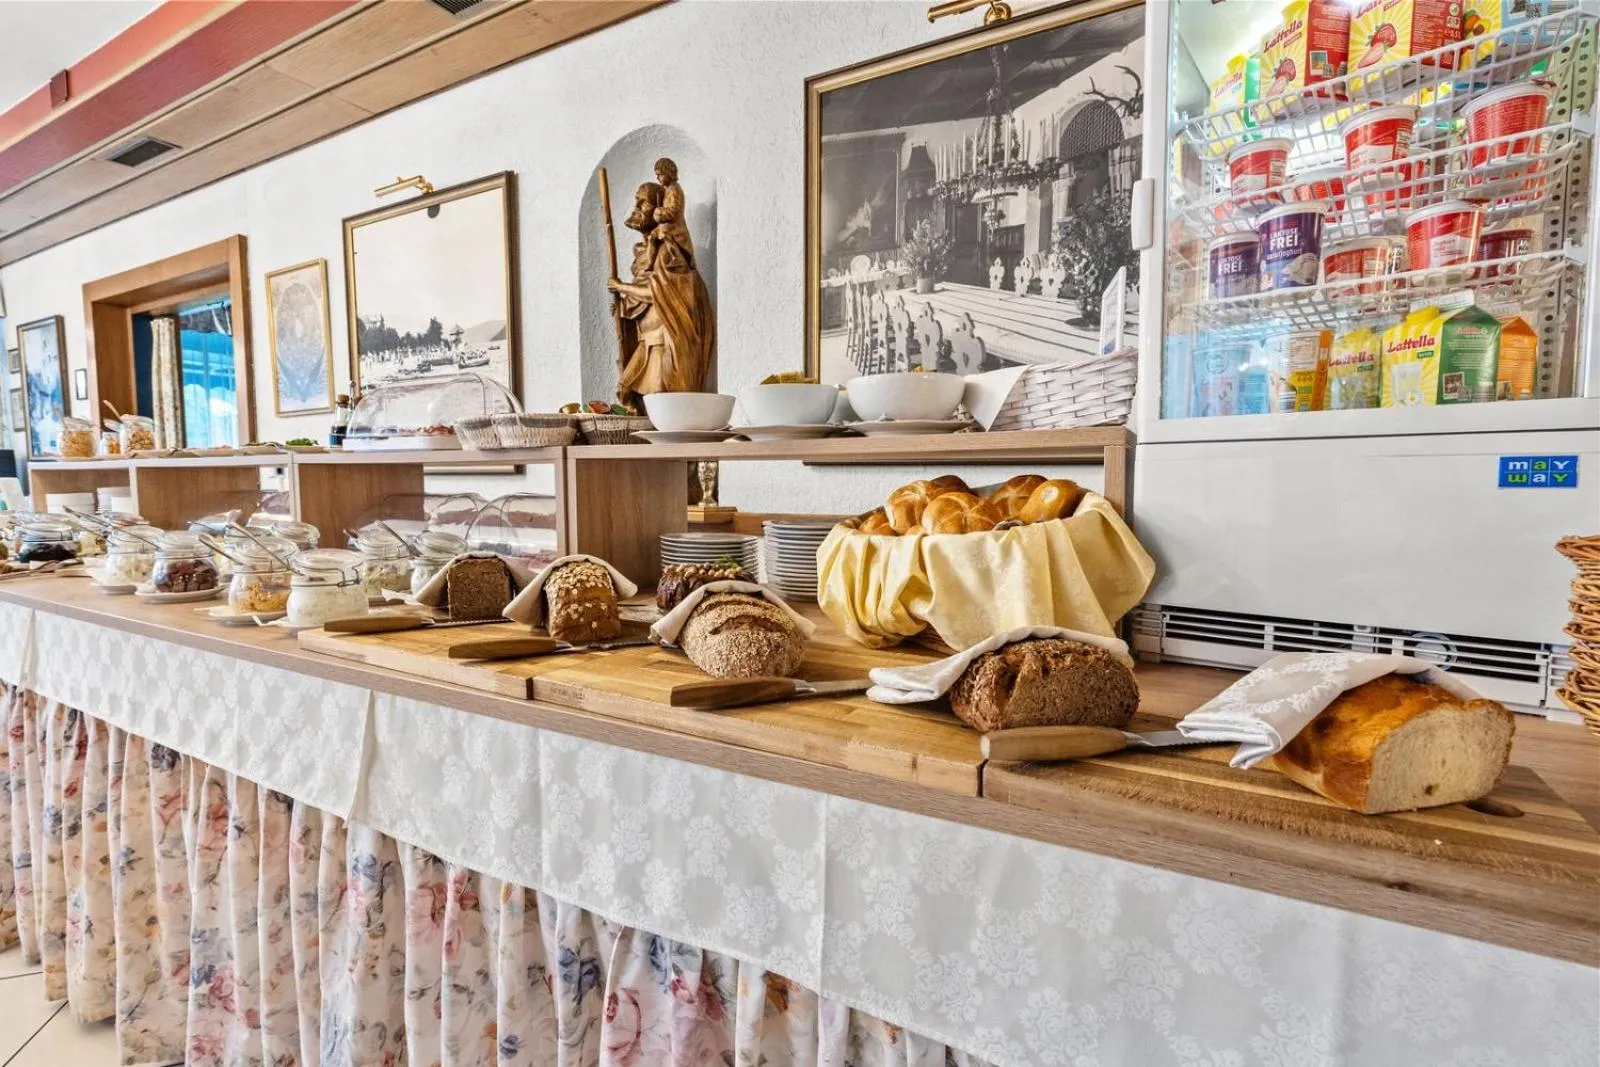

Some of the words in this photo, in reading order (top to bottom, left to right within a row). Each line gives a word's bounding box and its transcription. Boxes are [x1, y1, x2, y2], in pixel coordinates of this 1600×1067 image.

[1263, 20, 1303, 53] Lattella
[1269, 235, 1299, 251] FREI
[1218, 261, 1243, 275] FREI
[1387, 334, 1435, 353] Lattella
[1328, 351, 1374, 367] Lattella
